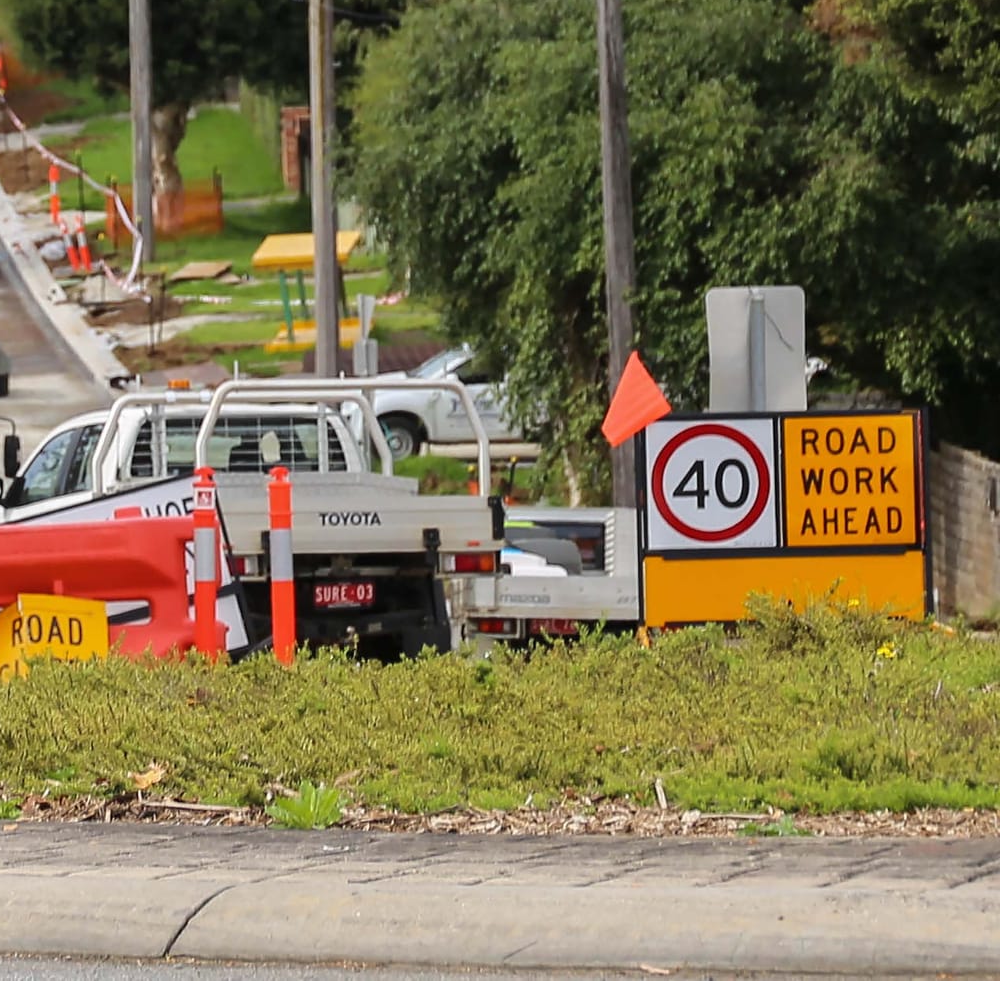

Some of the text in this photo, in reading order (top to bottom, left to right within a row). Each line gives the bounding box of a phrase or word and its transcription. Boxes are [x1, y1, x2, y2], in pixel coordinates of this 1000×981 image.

[801, 427, 897, 455] ROAD
[672, 459, 751, 509] 40
[801, 467, 899, 495] WORK
[319, 511, 382, 527] TOYOTA
[801, 507, 903, 536] AHEAD
[12, 614, 83, 648] ROAD
